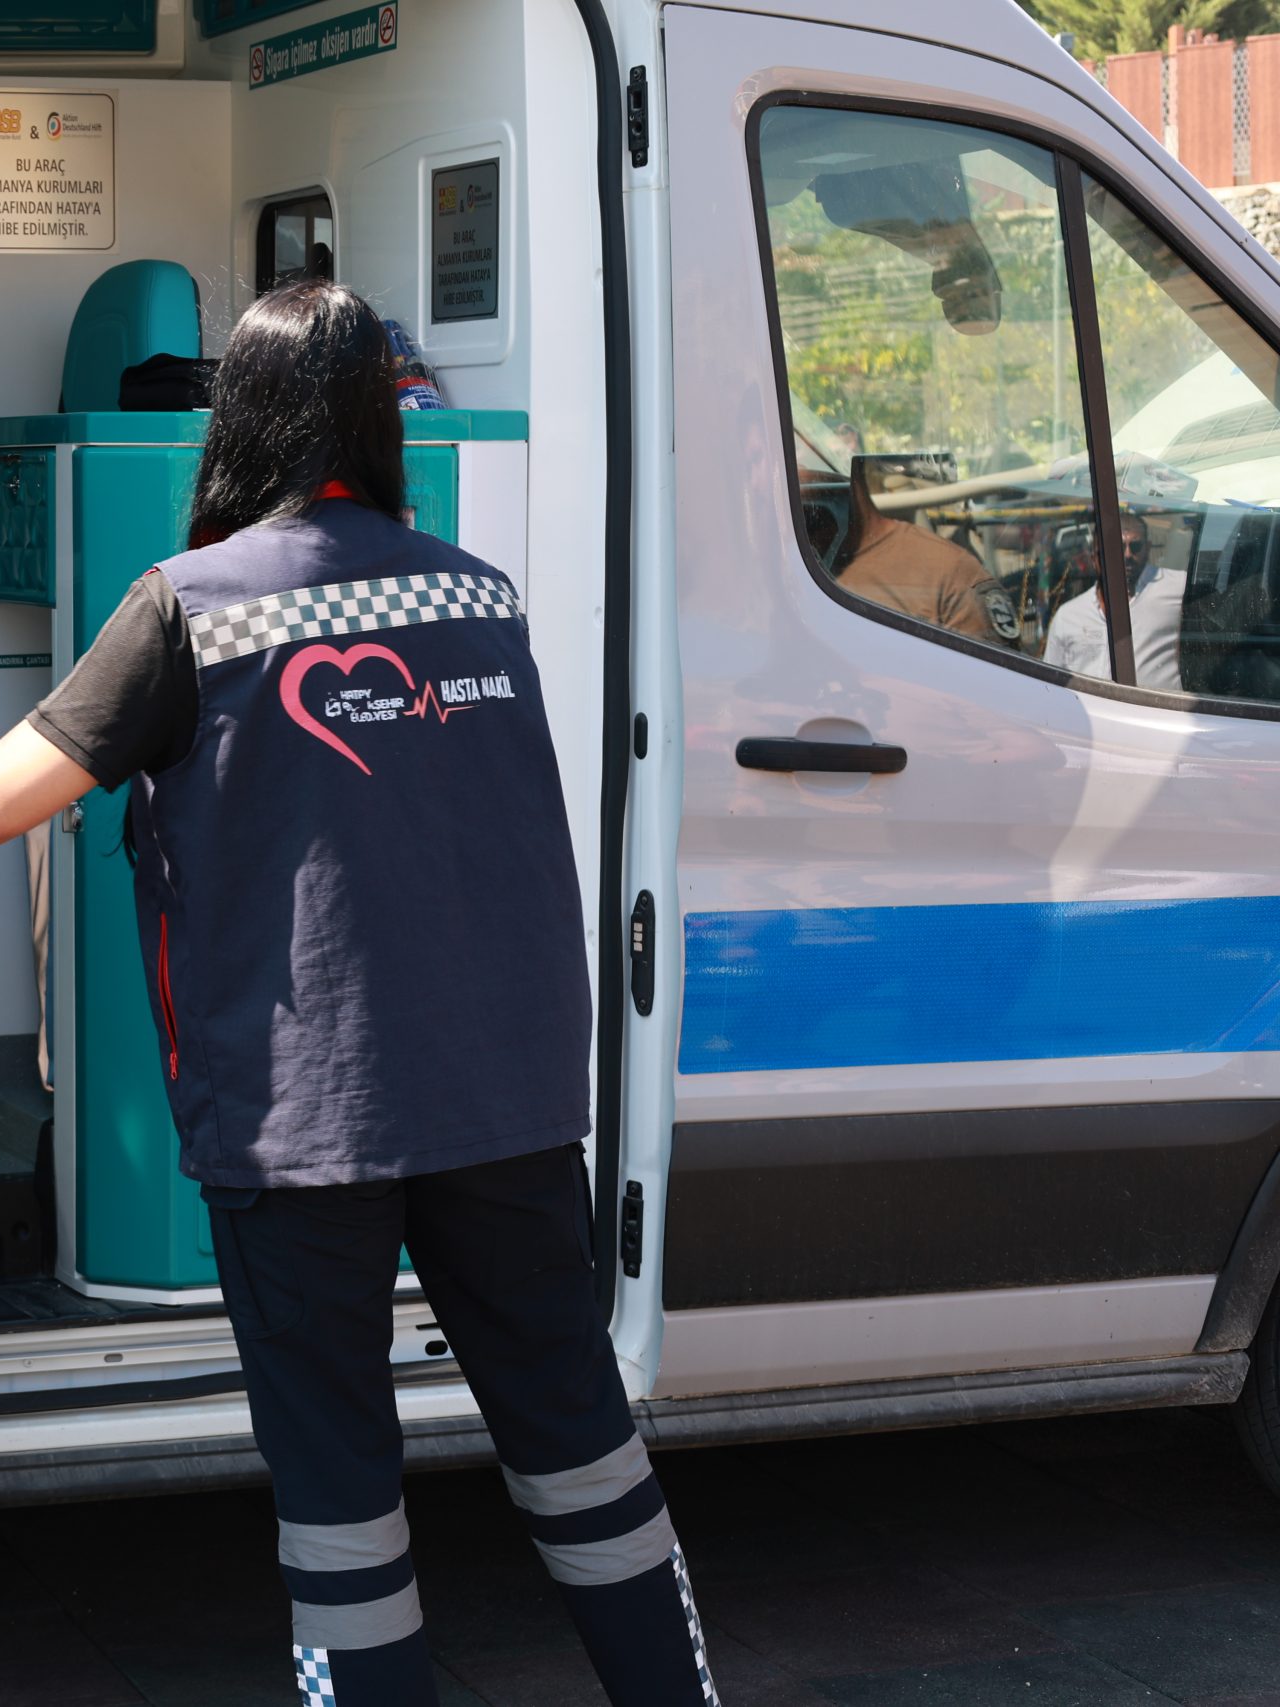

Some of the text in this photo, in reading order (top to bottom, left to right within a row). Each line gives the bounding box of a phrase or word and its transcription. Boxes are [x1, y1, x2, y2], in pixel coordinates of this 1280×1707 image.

[265, 17, 377, 80] Sigara içilmez oksijen vardır
[30, 125, 40, 140] &
[16, 158, 66, 177] BU ARAÇ
[37, 180, 103, 194] KURUMLARI
[56, 201, 102, 215] HATAY'A
[22, 218, 89, 240] EDİLMİŞTİR.
[453, 229, 476, 246] BU ARAÇ
[437, 251, 462, 266] ALMANYA
[440, 670, 516, 703] HASTA NAKİL
